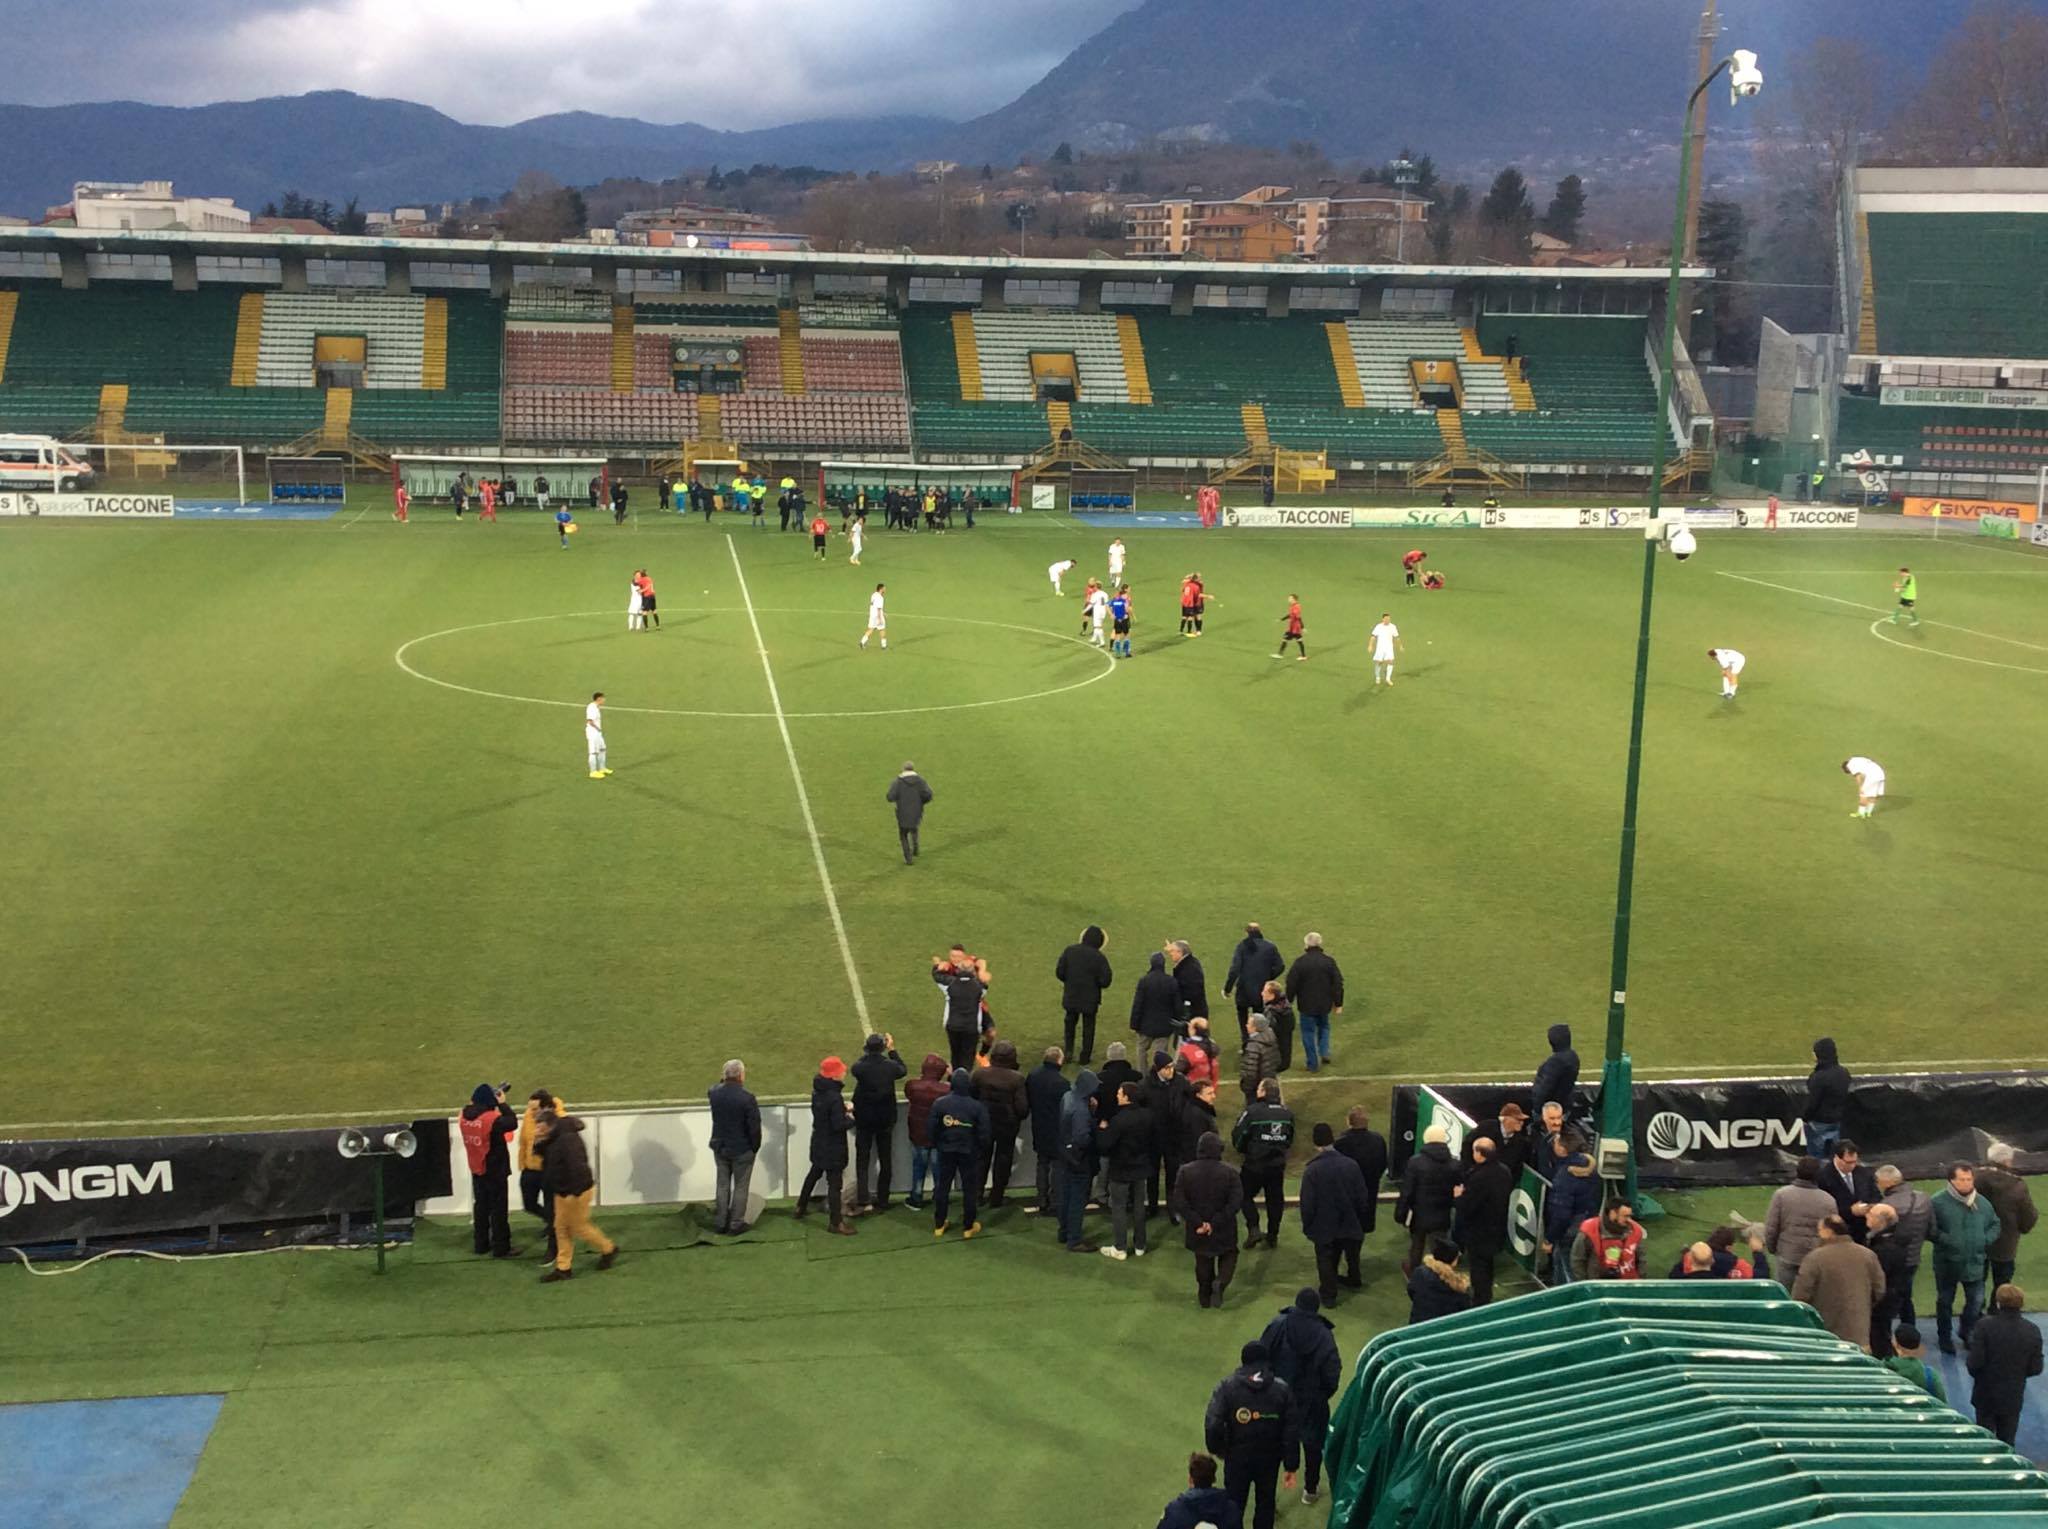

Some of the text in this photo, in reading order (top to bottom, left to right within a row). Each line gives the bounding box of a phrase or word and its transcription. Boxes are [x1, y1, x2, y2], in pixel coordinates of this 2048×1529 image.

[83, 497, 172, 514] TACCONE
[1940, 503, 2020, 519] GIVOVA
[1277, 510, 1351, 525] TACCONE
[1789, 511, 1856, 524] TACCONE
[1690, 1117, 1808, 1150] NGM
[21, 1160, 173, 1205] NGM
